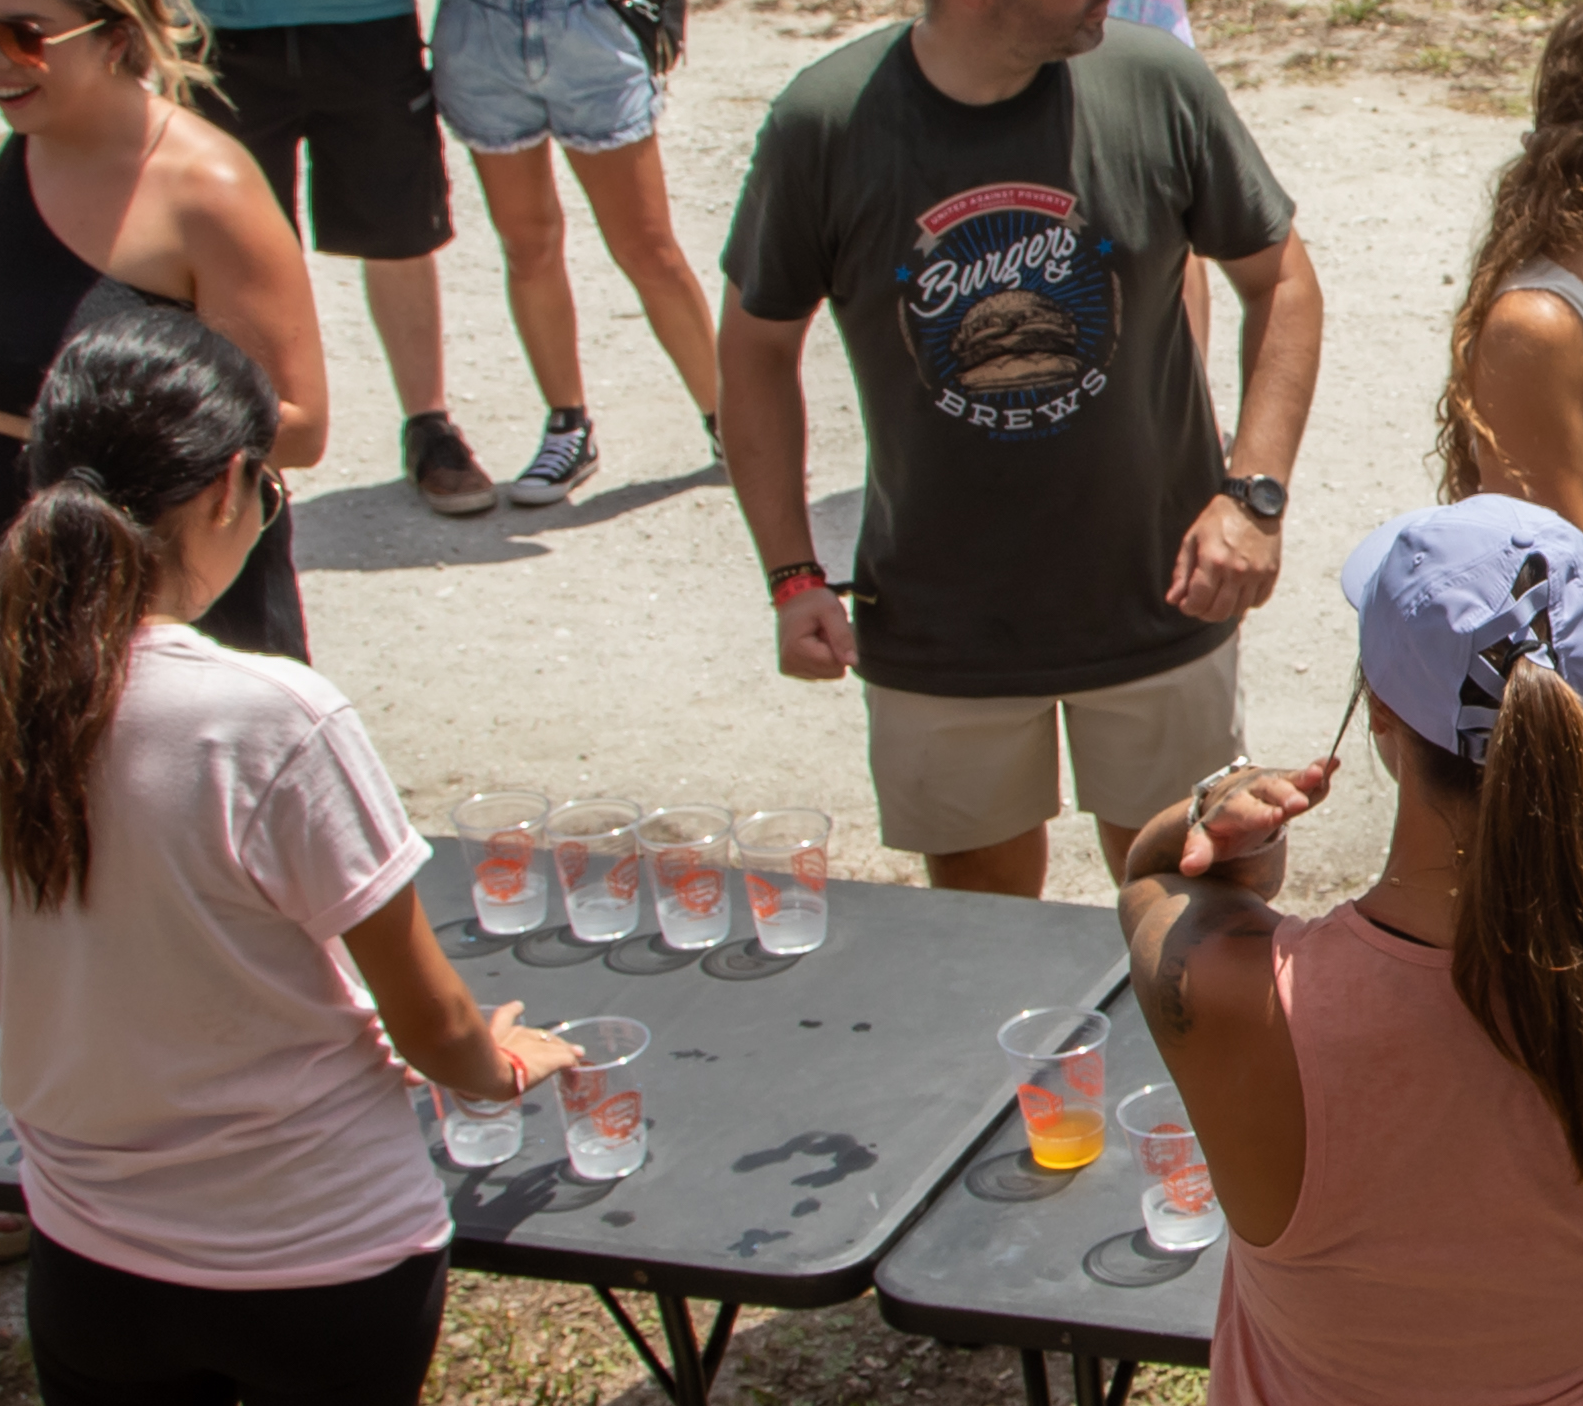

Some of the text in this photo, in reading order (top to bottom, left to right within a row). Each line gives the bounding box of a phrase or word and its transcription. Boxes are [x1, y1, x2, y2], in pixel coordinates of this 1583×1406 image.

[930, 190, 1068, 225] UNITED AGAINST POVERTY
[910, 226, 1077, 317] Burgers
[1044, 259, 1072, 283] &
[934, 368, 1107, 430] BREWS
